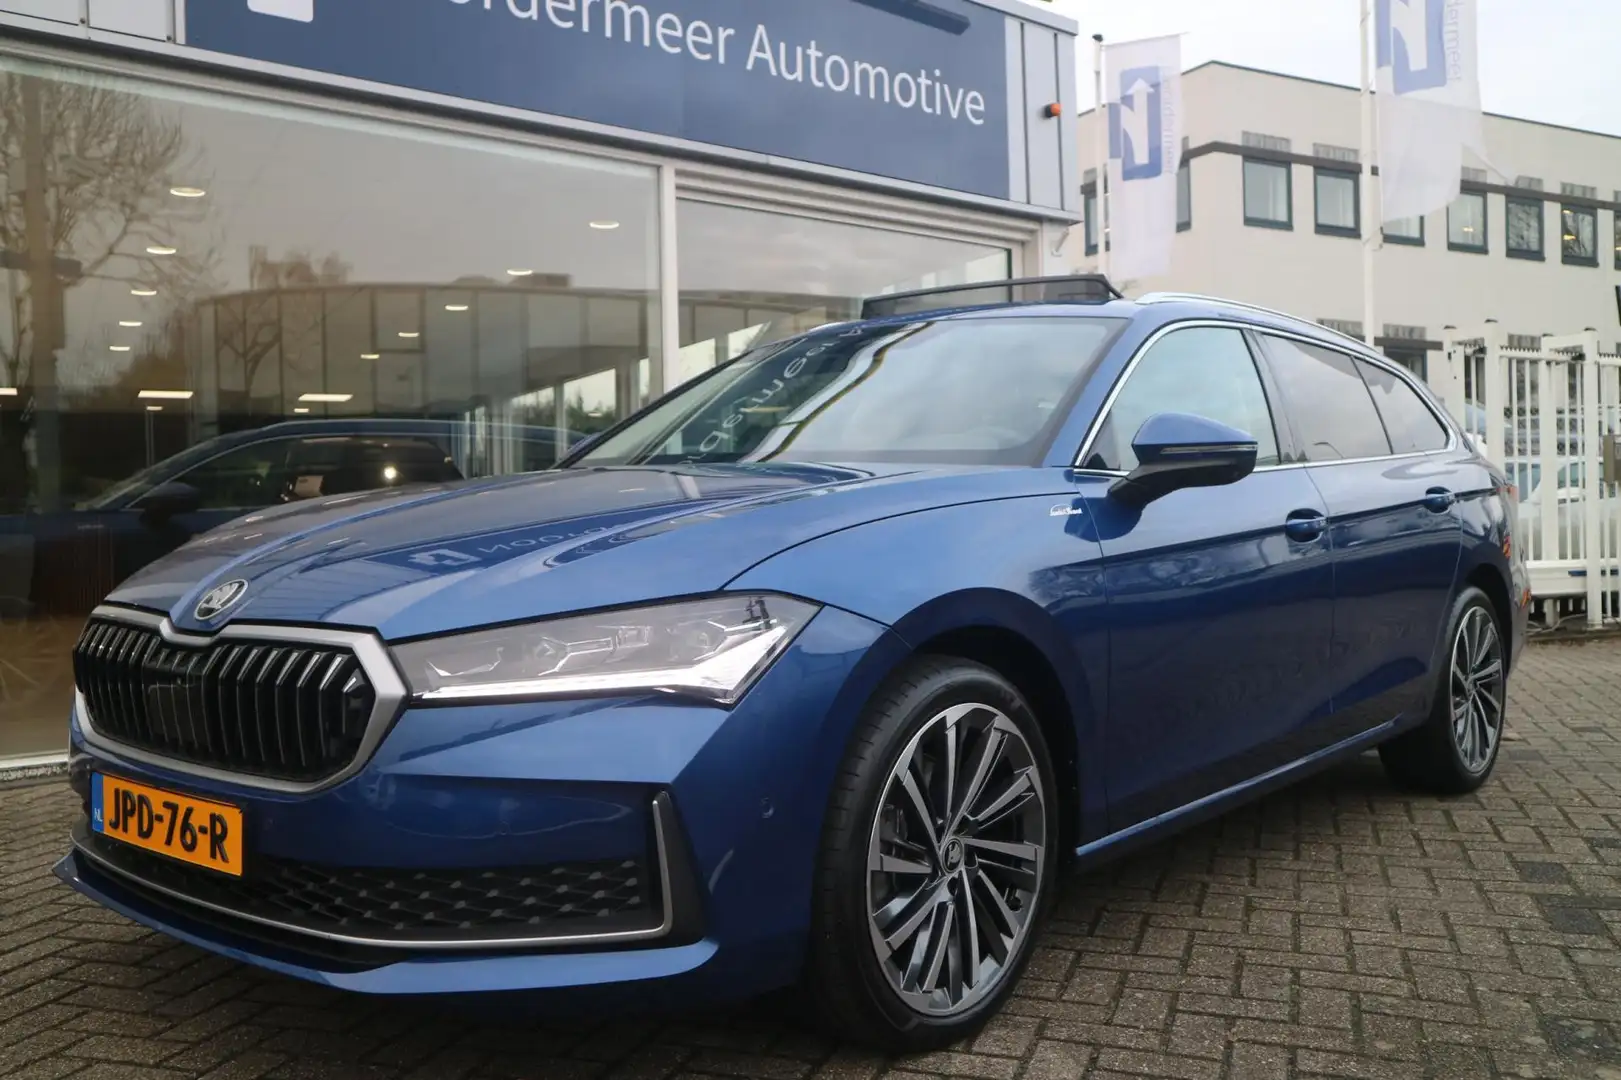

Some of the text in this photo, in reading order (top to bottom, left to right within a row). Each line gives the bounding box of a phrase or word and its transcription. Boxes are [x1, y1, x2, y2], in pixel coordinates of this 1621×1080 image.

[449, 0, 985, 125] ermeer Automotive
[94, 808, 103, 822] NL
[109, 788, 229, 864] JPD-76-R
